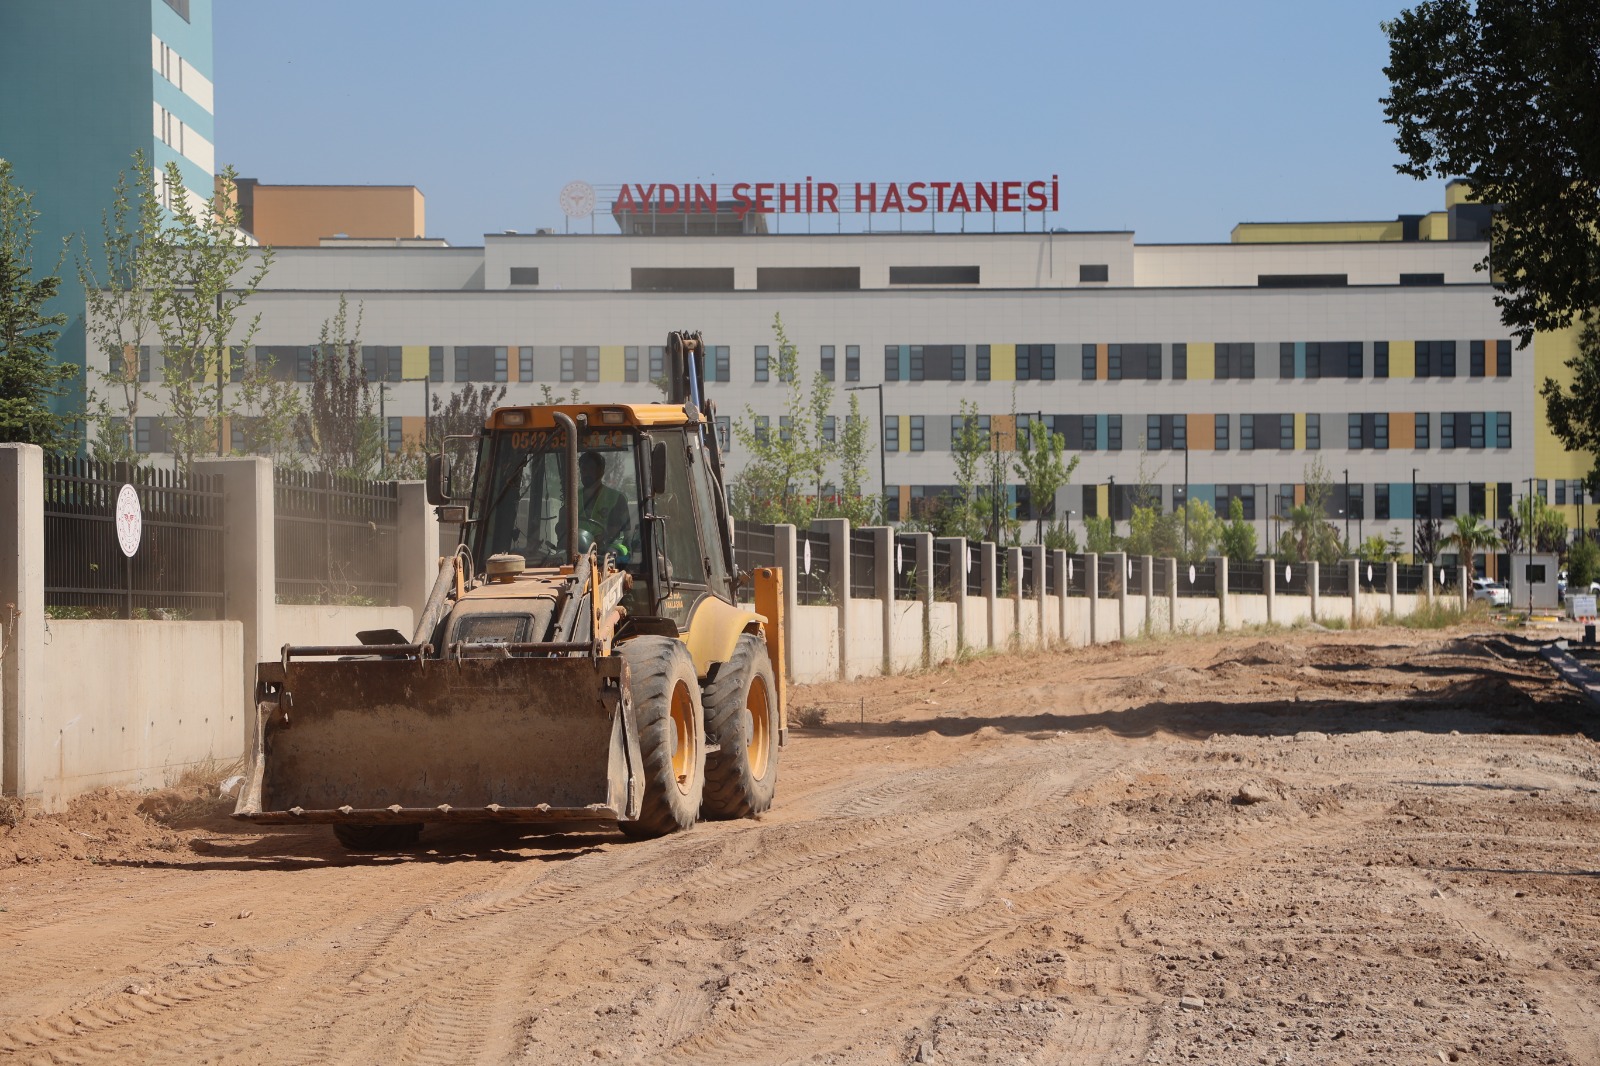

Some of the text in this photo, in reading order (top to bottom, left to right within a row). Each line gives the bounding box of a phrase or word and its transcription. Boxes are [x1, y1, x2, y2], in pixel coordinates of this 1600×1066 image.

[617, 174, 1059, 220] AYDIN ŞEHİR HASTANESİ
